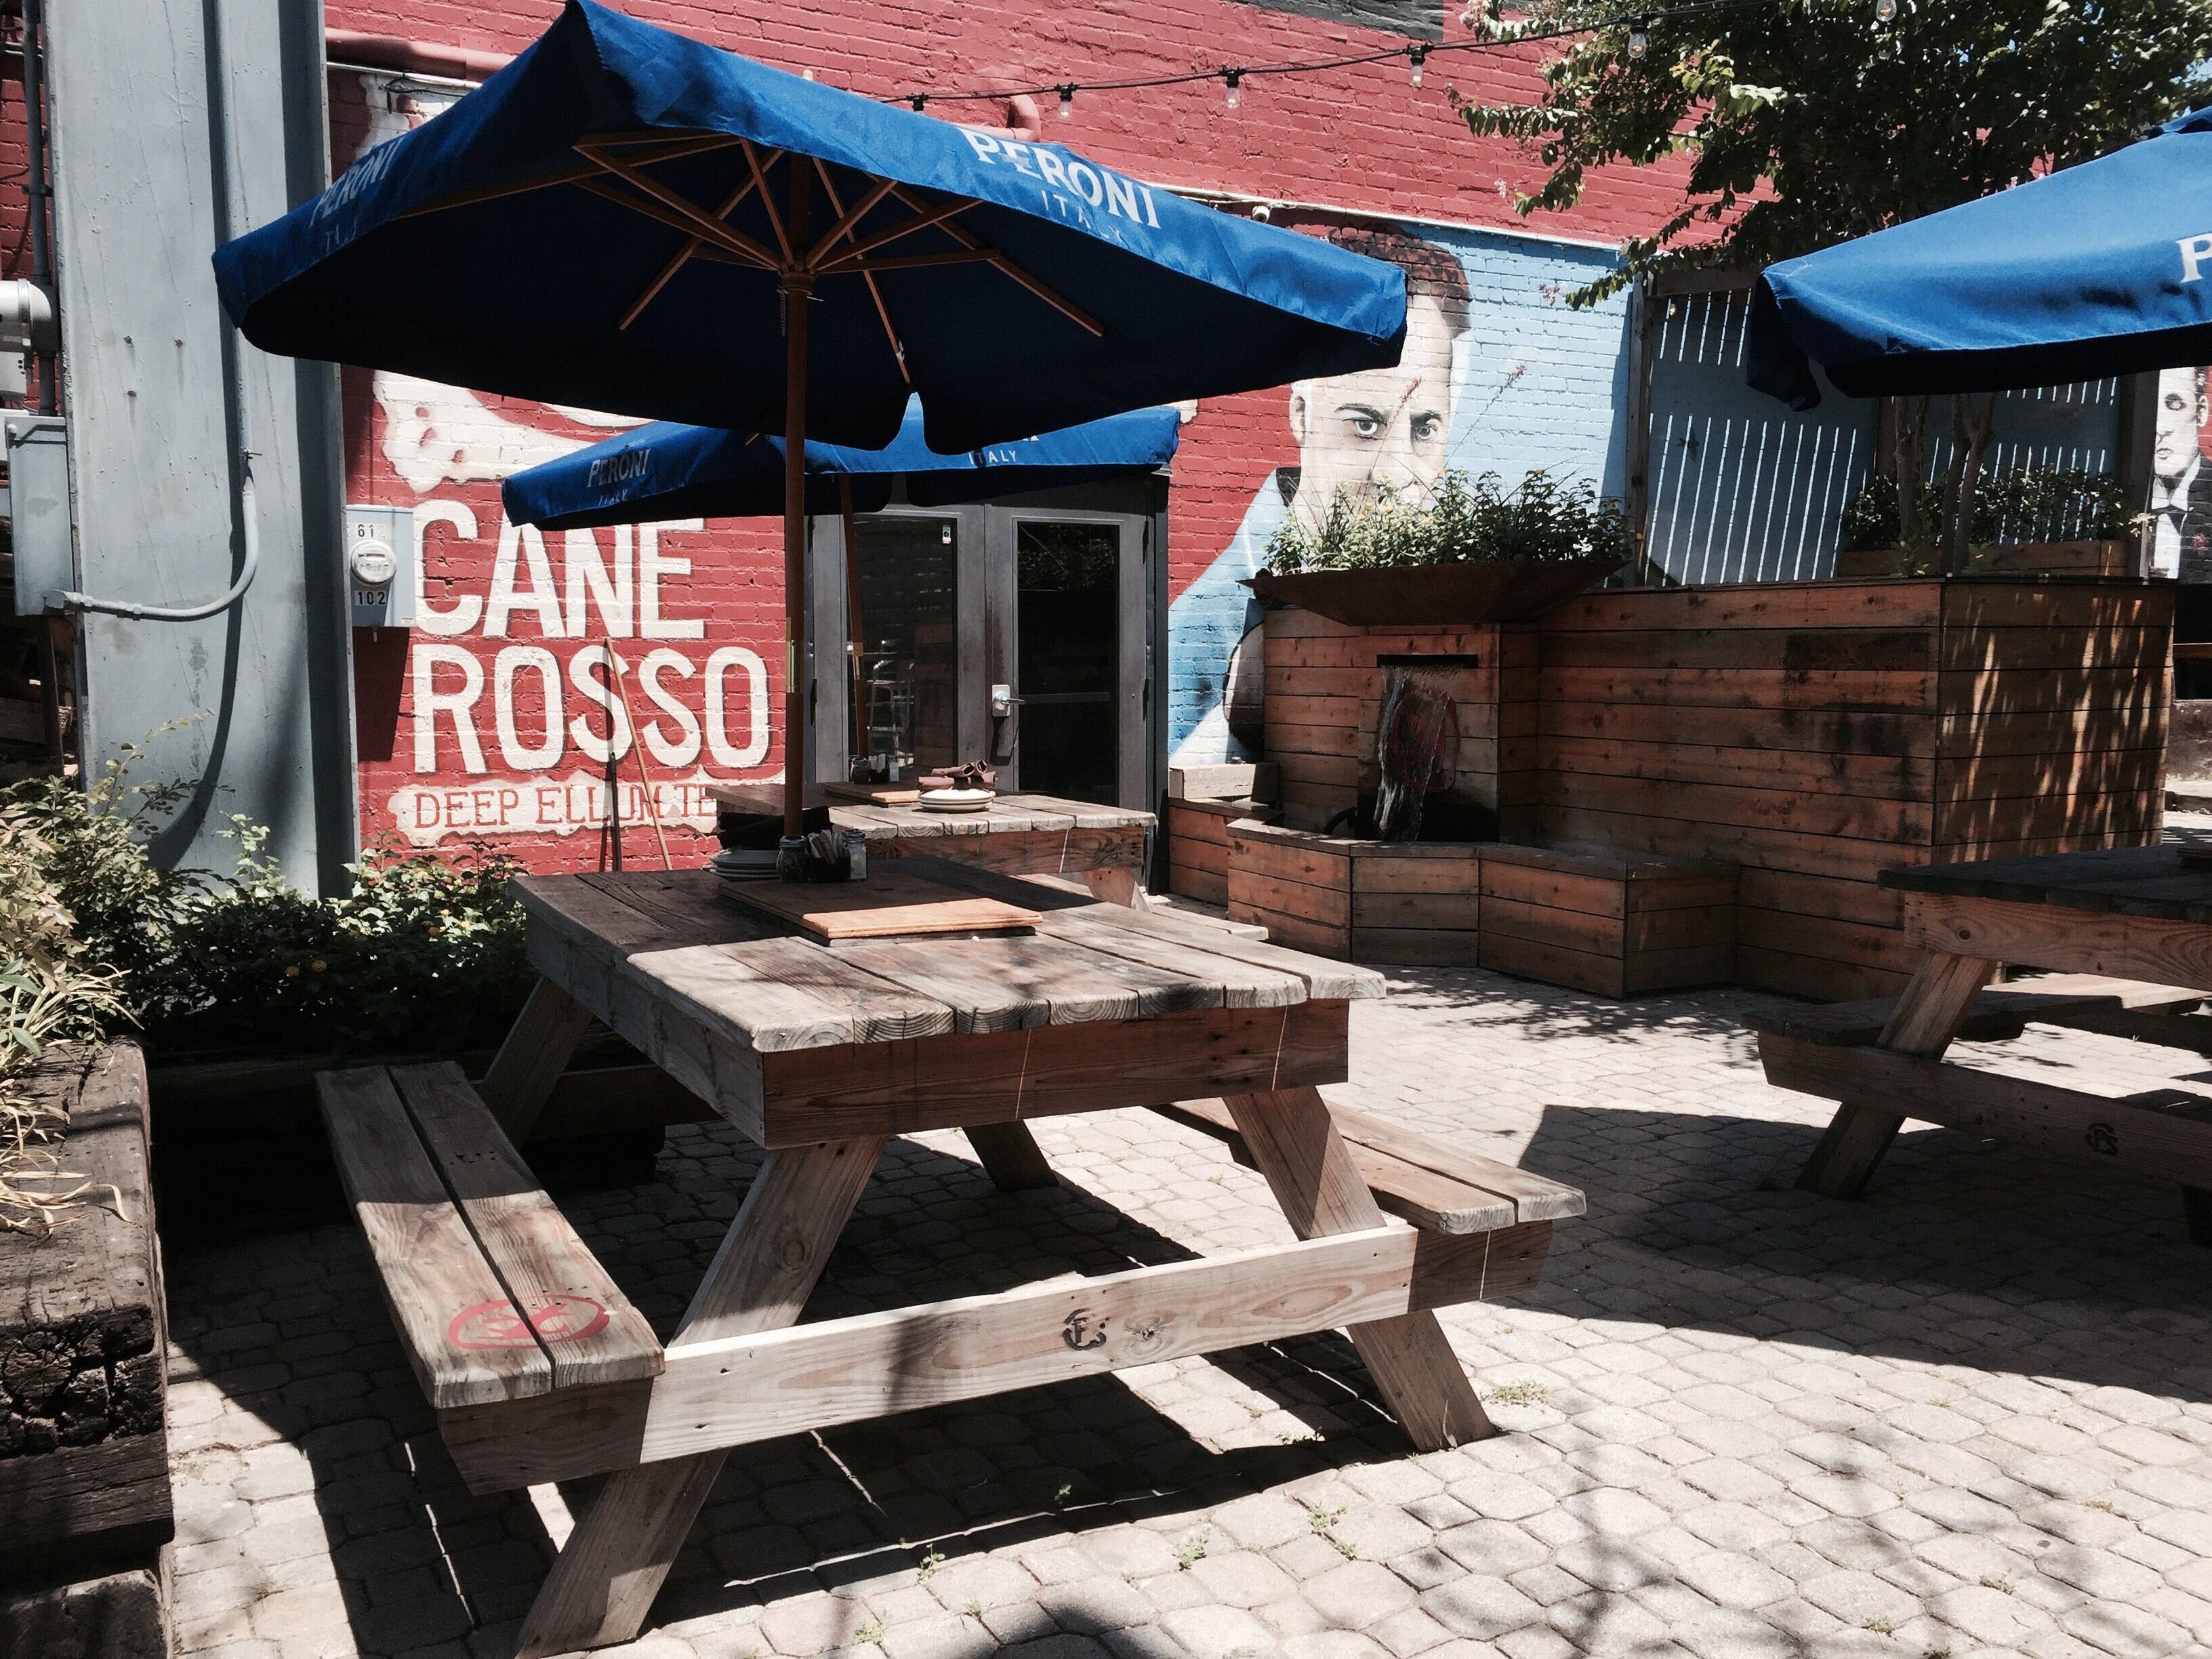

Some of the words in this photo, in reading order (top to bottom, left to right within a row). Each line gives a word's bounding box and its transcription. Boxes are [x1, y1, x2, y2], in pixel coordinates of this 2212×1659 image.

[309, 136, 405, 228] PERONI
[958, 127, 1162, 229] PERONI
[1042, 190, 1124, 245] ITALY
[587, 448, 651, 488] PERONI
[968, 450, 1017, 465] ITALY
[413, 499, 705, 639] CANE
[357, 591, 386, 605] 102
[411, 643, 771, 774] ROSSO
[414, 788, 519, 828] DEEP
[535, 784, 665, 824] ELLUM
